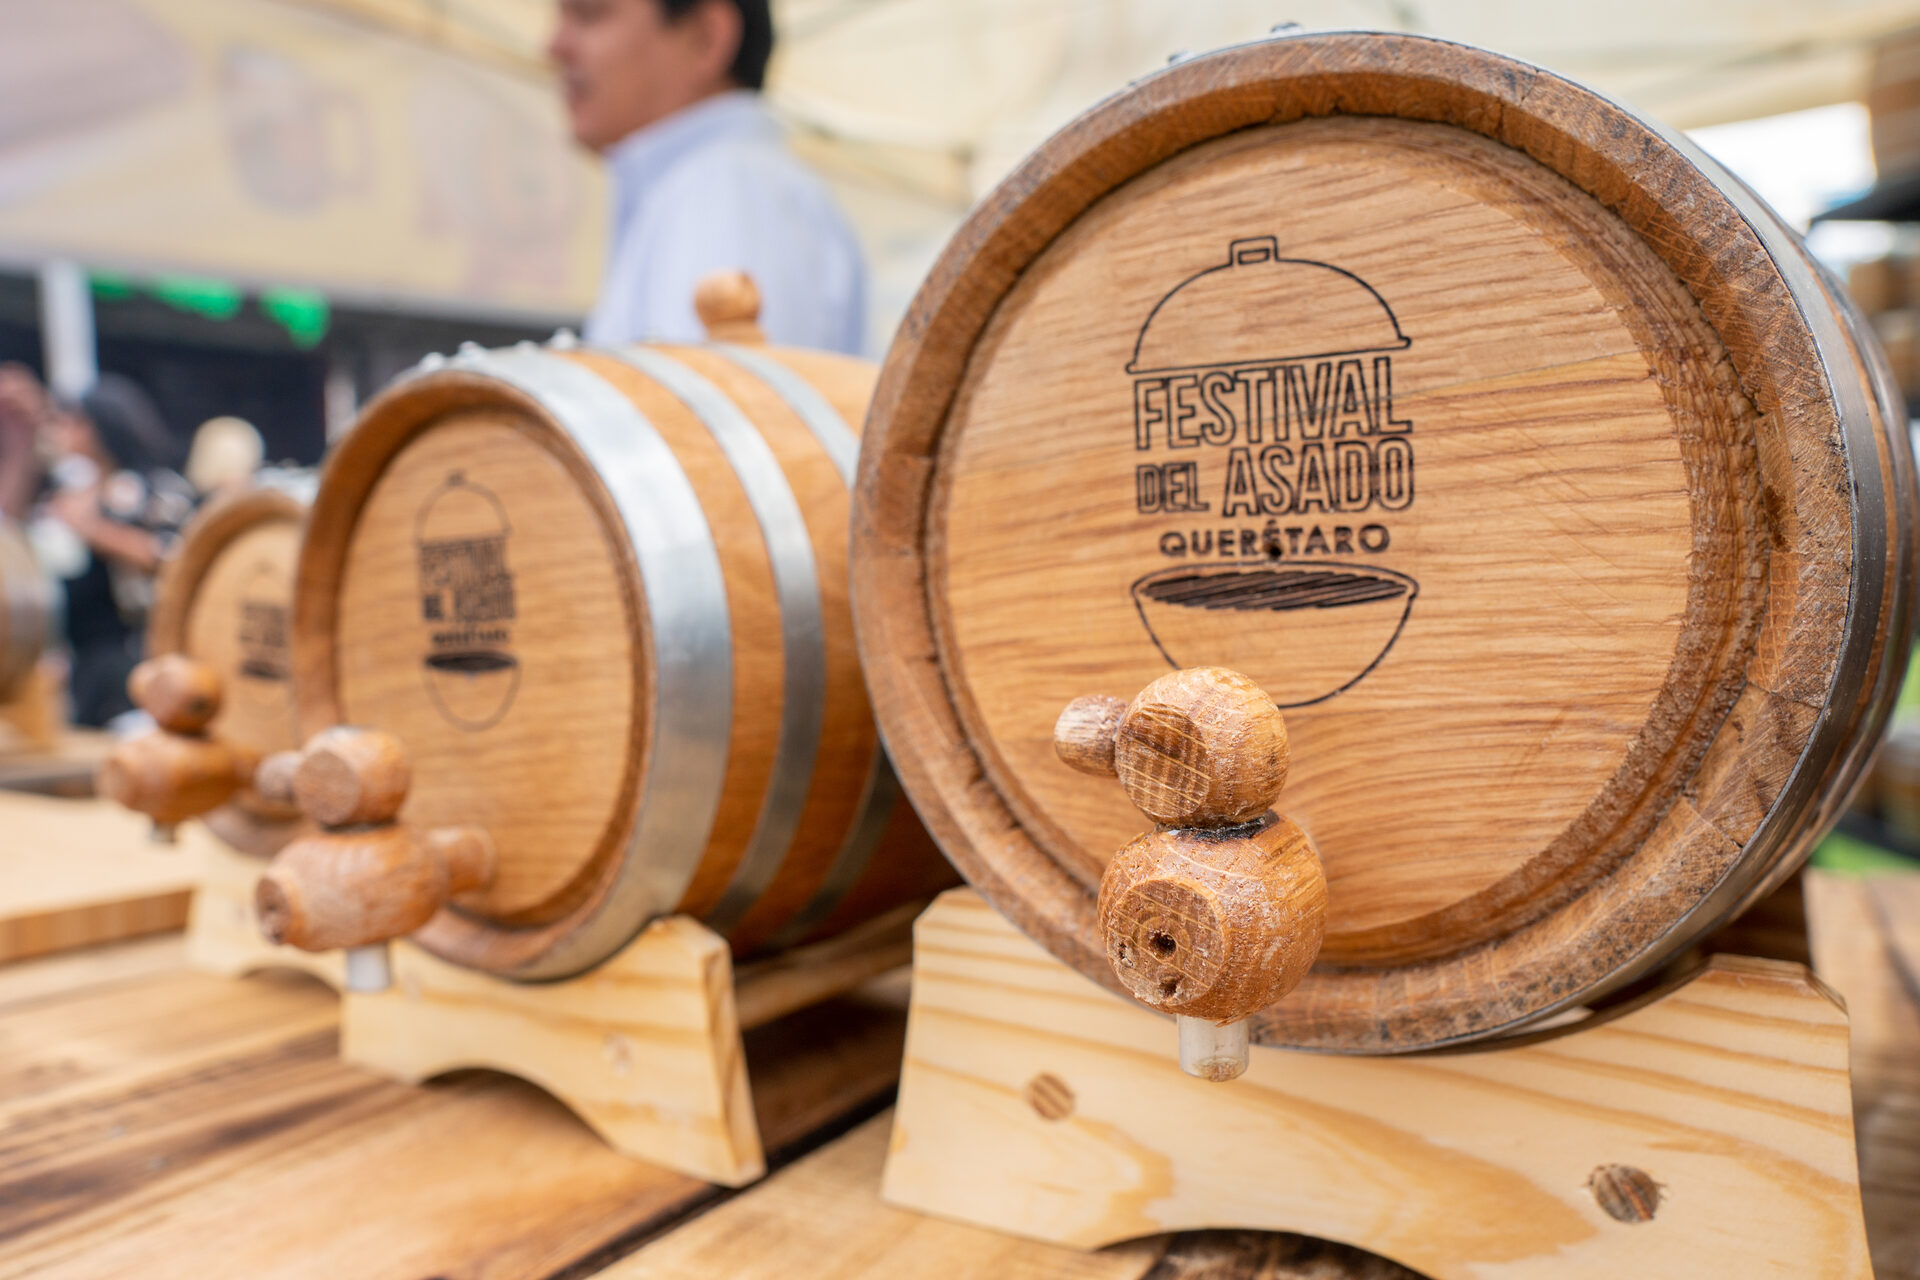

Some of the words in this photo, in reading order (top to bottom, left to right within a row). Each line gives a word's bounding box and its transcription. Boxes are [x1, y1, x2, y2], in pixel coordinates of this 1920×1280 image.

[1134, 356, 1412, 450] FESTIVAL
[1136, 461, 1209, 514] DEL
[1222, 437, 1414, 518] ASADO
[1159, 520, 1390, 557] QUERÉTARO
